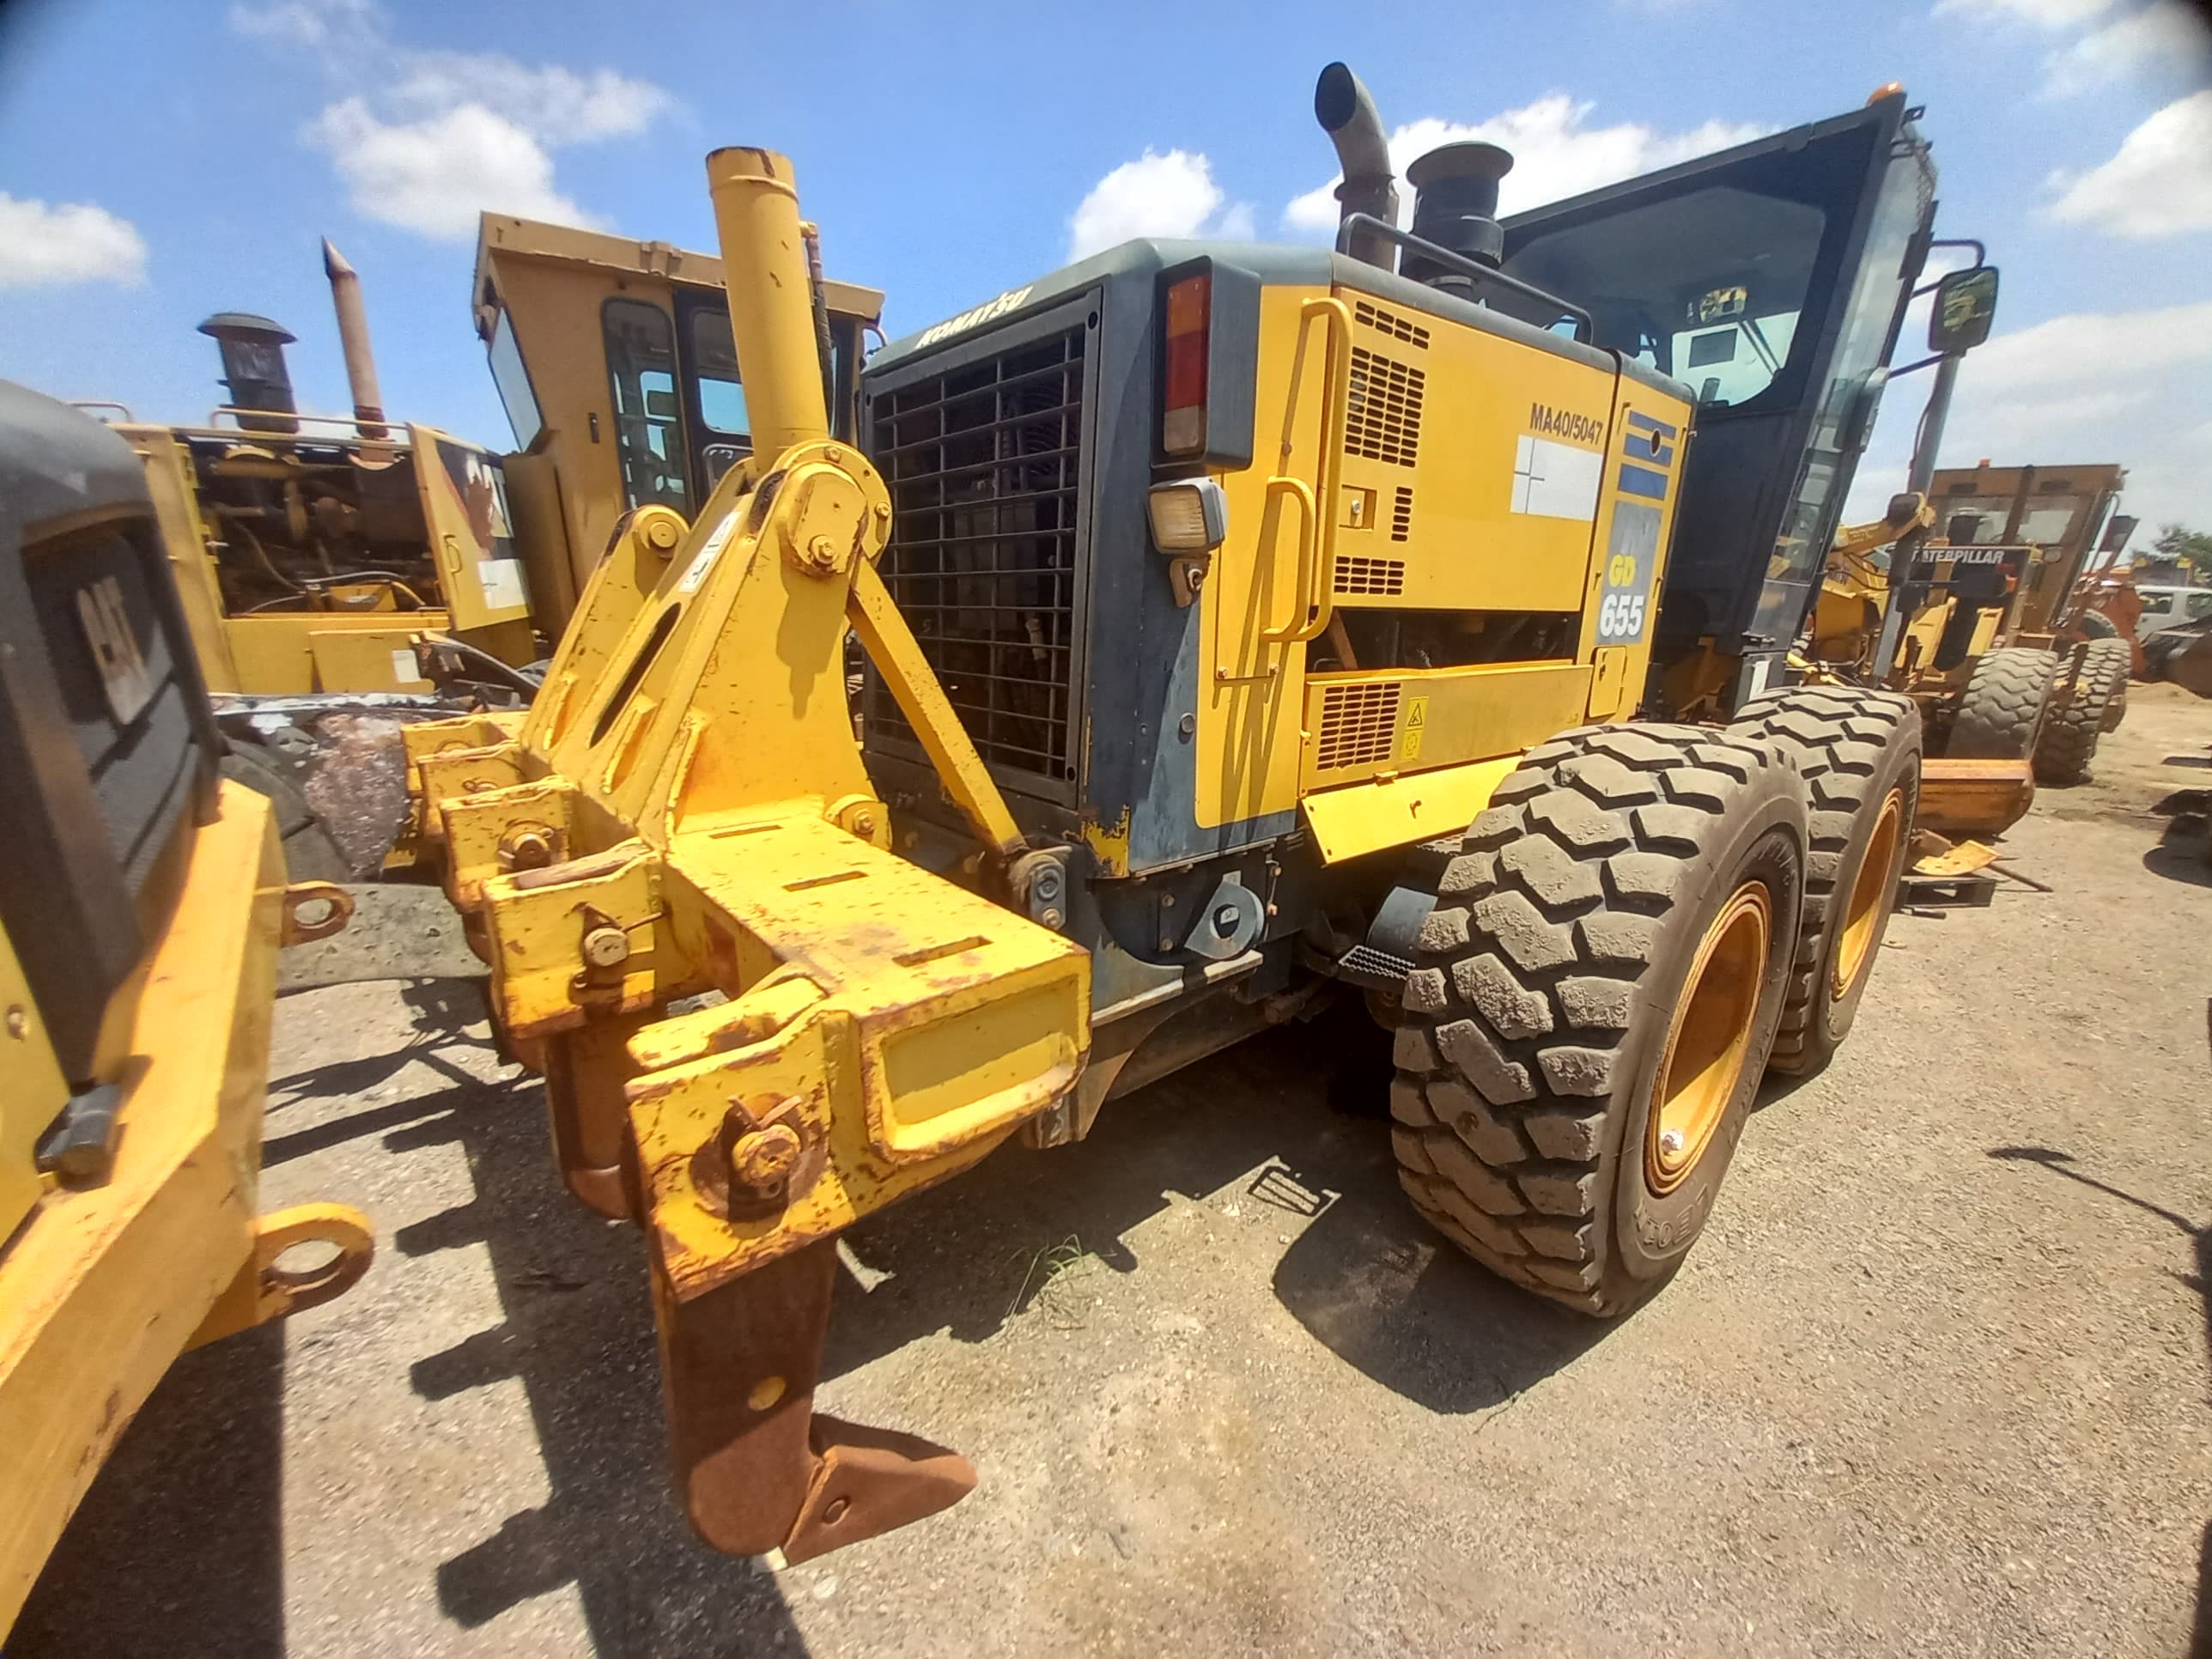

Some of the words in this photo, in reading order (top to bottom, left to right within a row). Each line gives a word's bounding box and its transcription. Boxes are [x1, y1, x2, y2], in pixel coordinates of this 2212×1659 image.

[1530, 403, 1603, 445] MA40/5047
[1609, 554, 1636, 586] GD
[1600, 594, 1644, 636] 655
